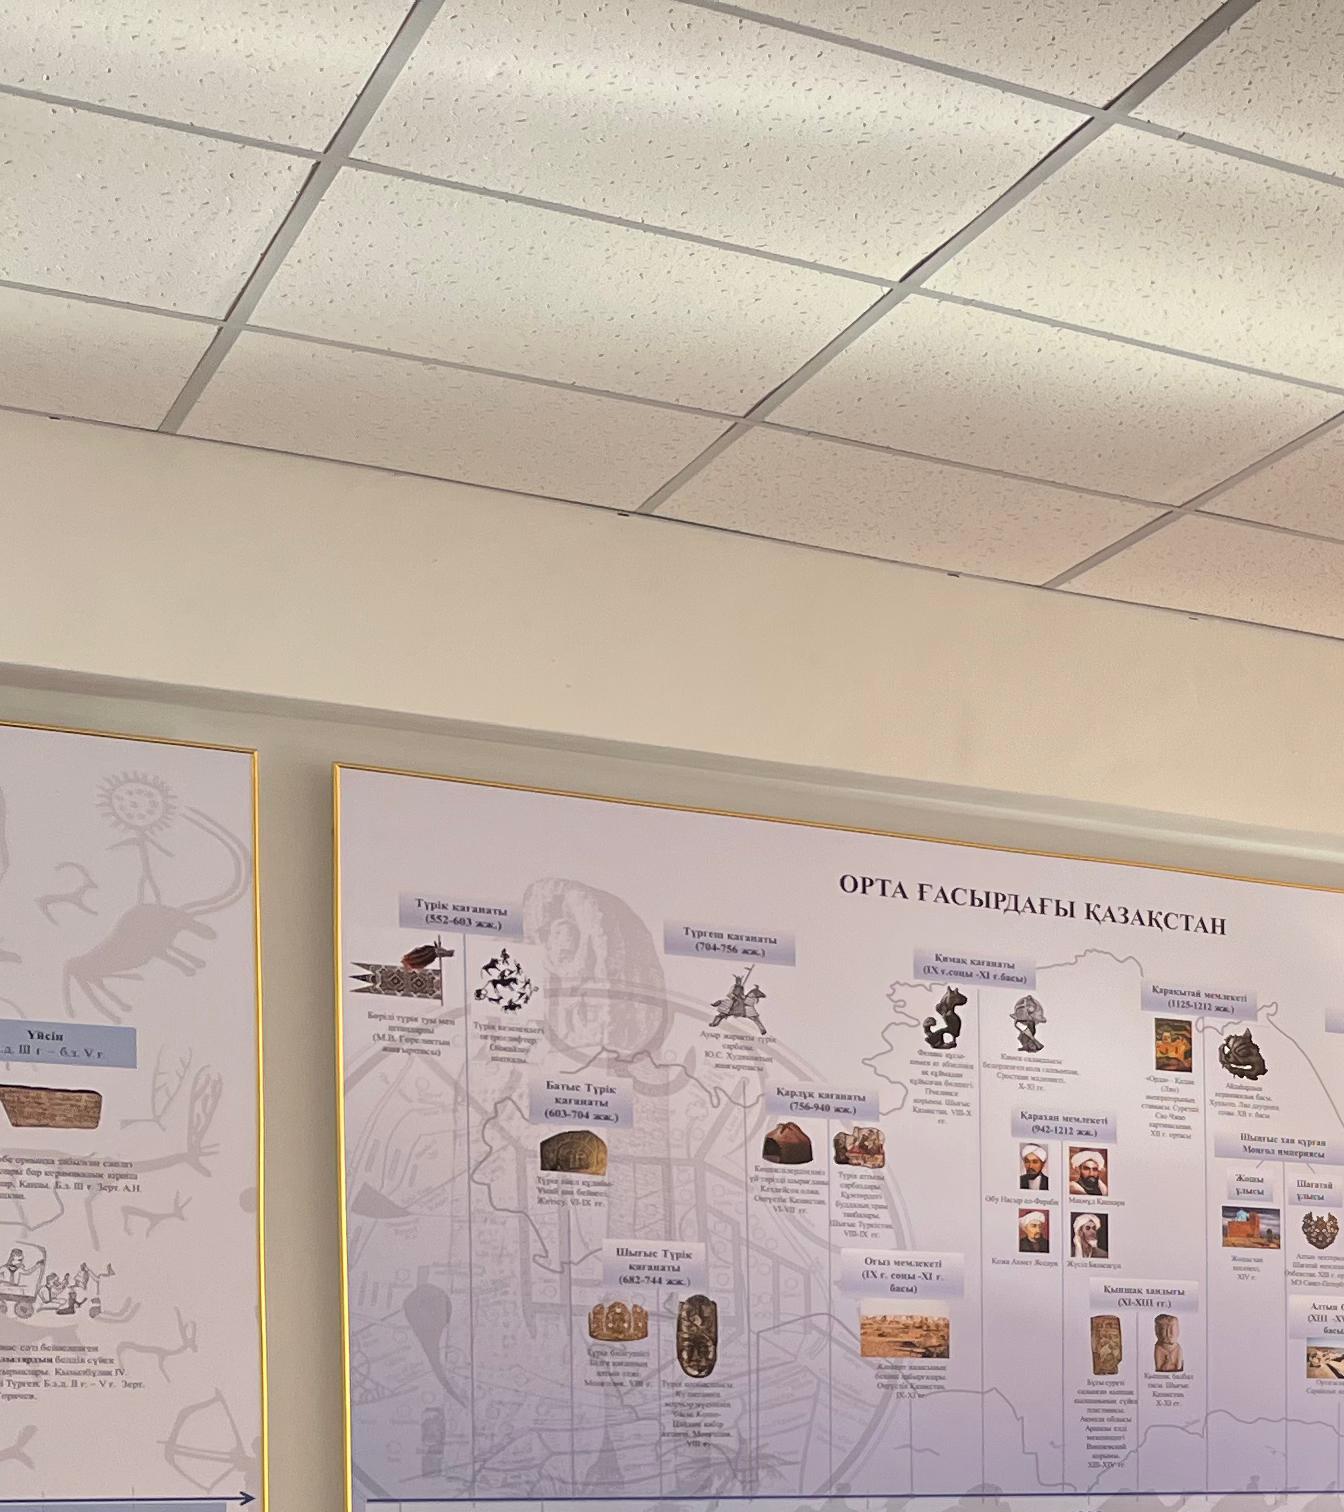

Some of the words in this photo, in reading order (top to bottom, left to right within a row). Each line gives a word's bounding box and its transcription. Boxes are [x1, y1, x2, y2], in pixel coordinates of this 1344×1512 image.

[415, 897, 449, 913] Түрік
[839, 873, 909, 901] ОРТА
[917, 882, 1076, 919] ҒАСЫРДАҒЫ
[1084, 900, 1227, 936] ҚАЗАҚСТАН
[425, 914, 473, 928] (552-603
[474, 919, 503, 932] жж.)
[683, 926, 724, 941] Түргеш
[695, 941, 739, 955] (704-756
[1203, 991, 1248, 1003] мемлекеті
[1167, 998, 1212, 1012] (1125-1212
[546, 1080, 581, 1092] Батыс
[584, 1083, 617, 1096] Түрік
[789, 1101, 831, 1113] (756-940
[544, 1109, 590, 1120] (603-704
[592, 1112, 619, 1123] жж.)
[1020, 1110, 1059, 1122] Қарахан
[1062, 1114, 1108, 1125] мемлекеті
[1031, 1124, 1074, 1136] (942-1212
[1076, 1128, 1098, 1138] жж.)
[1280, 1137, 1296, 1145] хан
[616, 1247, 658, 1259] Шығыс
[661, 1249, 693, 1262] Түрік
[864, 1256, 891, 1267] Оғыз
[893, 1258, 942, 1269] мемлекеті
[618, 1274, 663, 1286] (682-744
[861, 1271, 878, 1281] (IX
[889, 1283, 918, 1294] басы)
[1310, 1302, 1338, 1313] Алтын
[1307, 1313, 1328, 1324] (XIII
